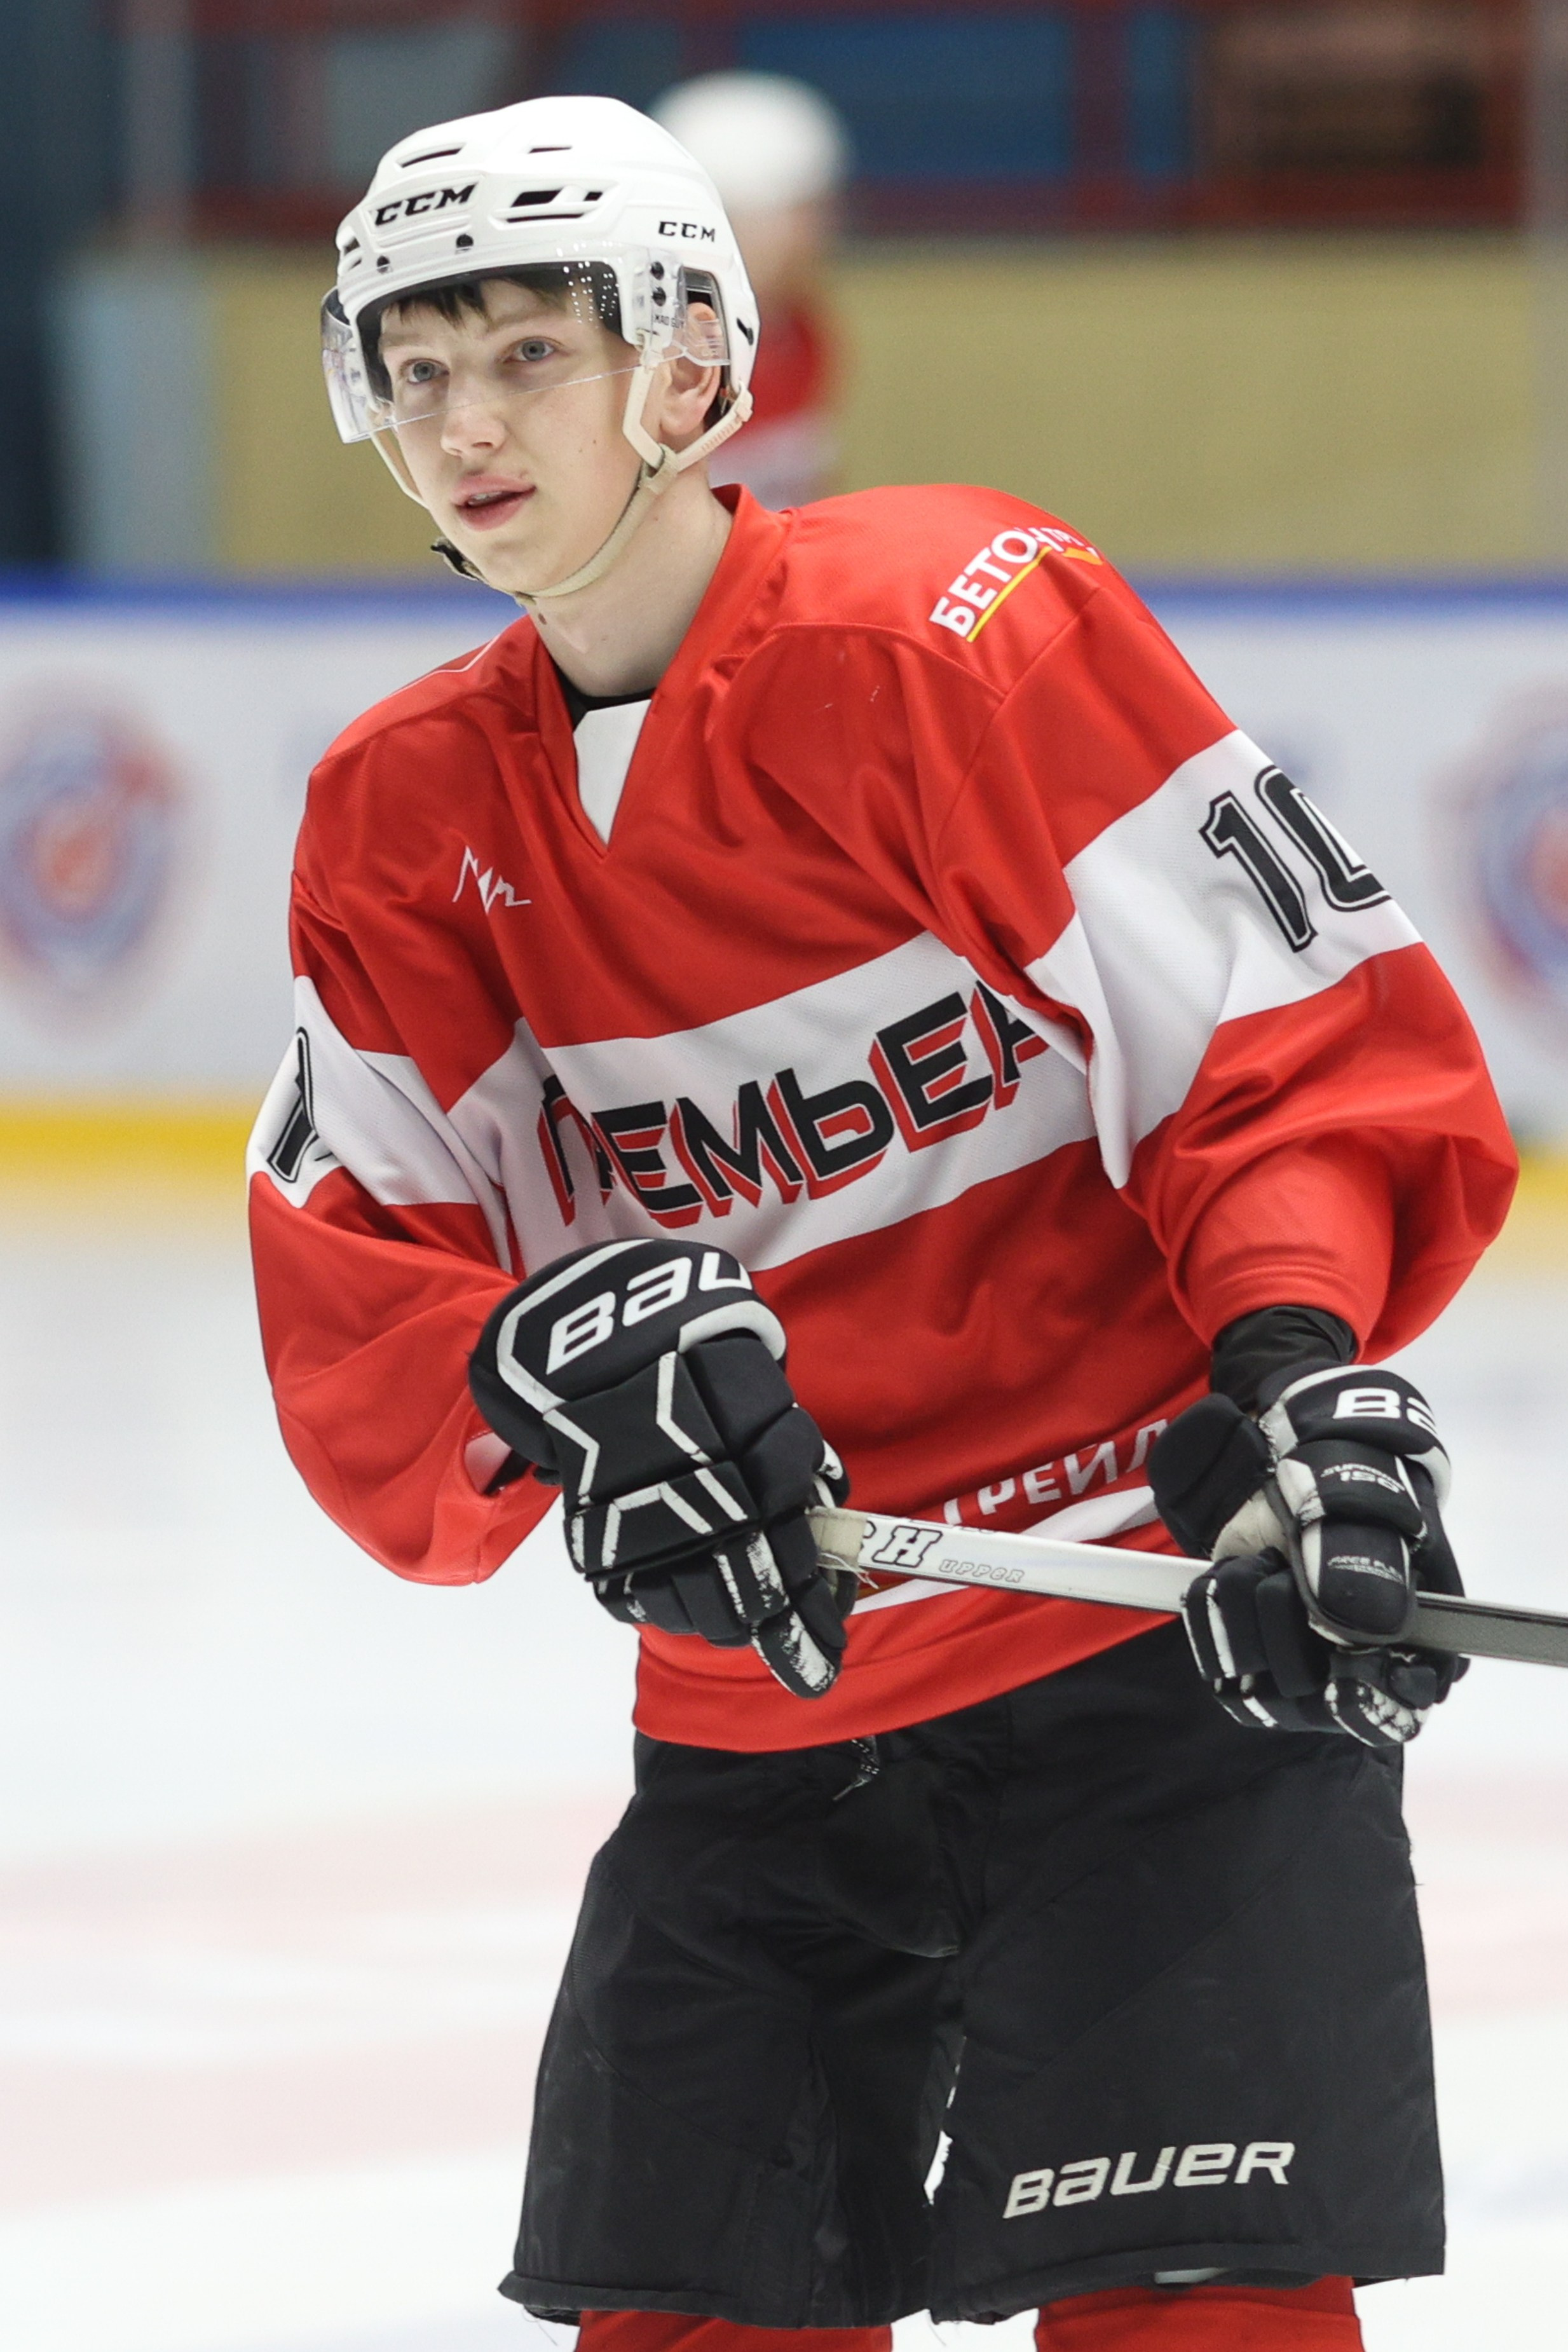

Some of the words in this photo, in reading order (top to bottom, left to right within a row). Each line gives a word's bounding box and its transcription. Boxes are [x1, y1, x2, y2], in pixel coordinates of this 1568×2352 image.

[374, 181, 479, 226] CCM
[658, 221, 716, 242] CCM
[939, 1559, 1025, 1583] UPPER
